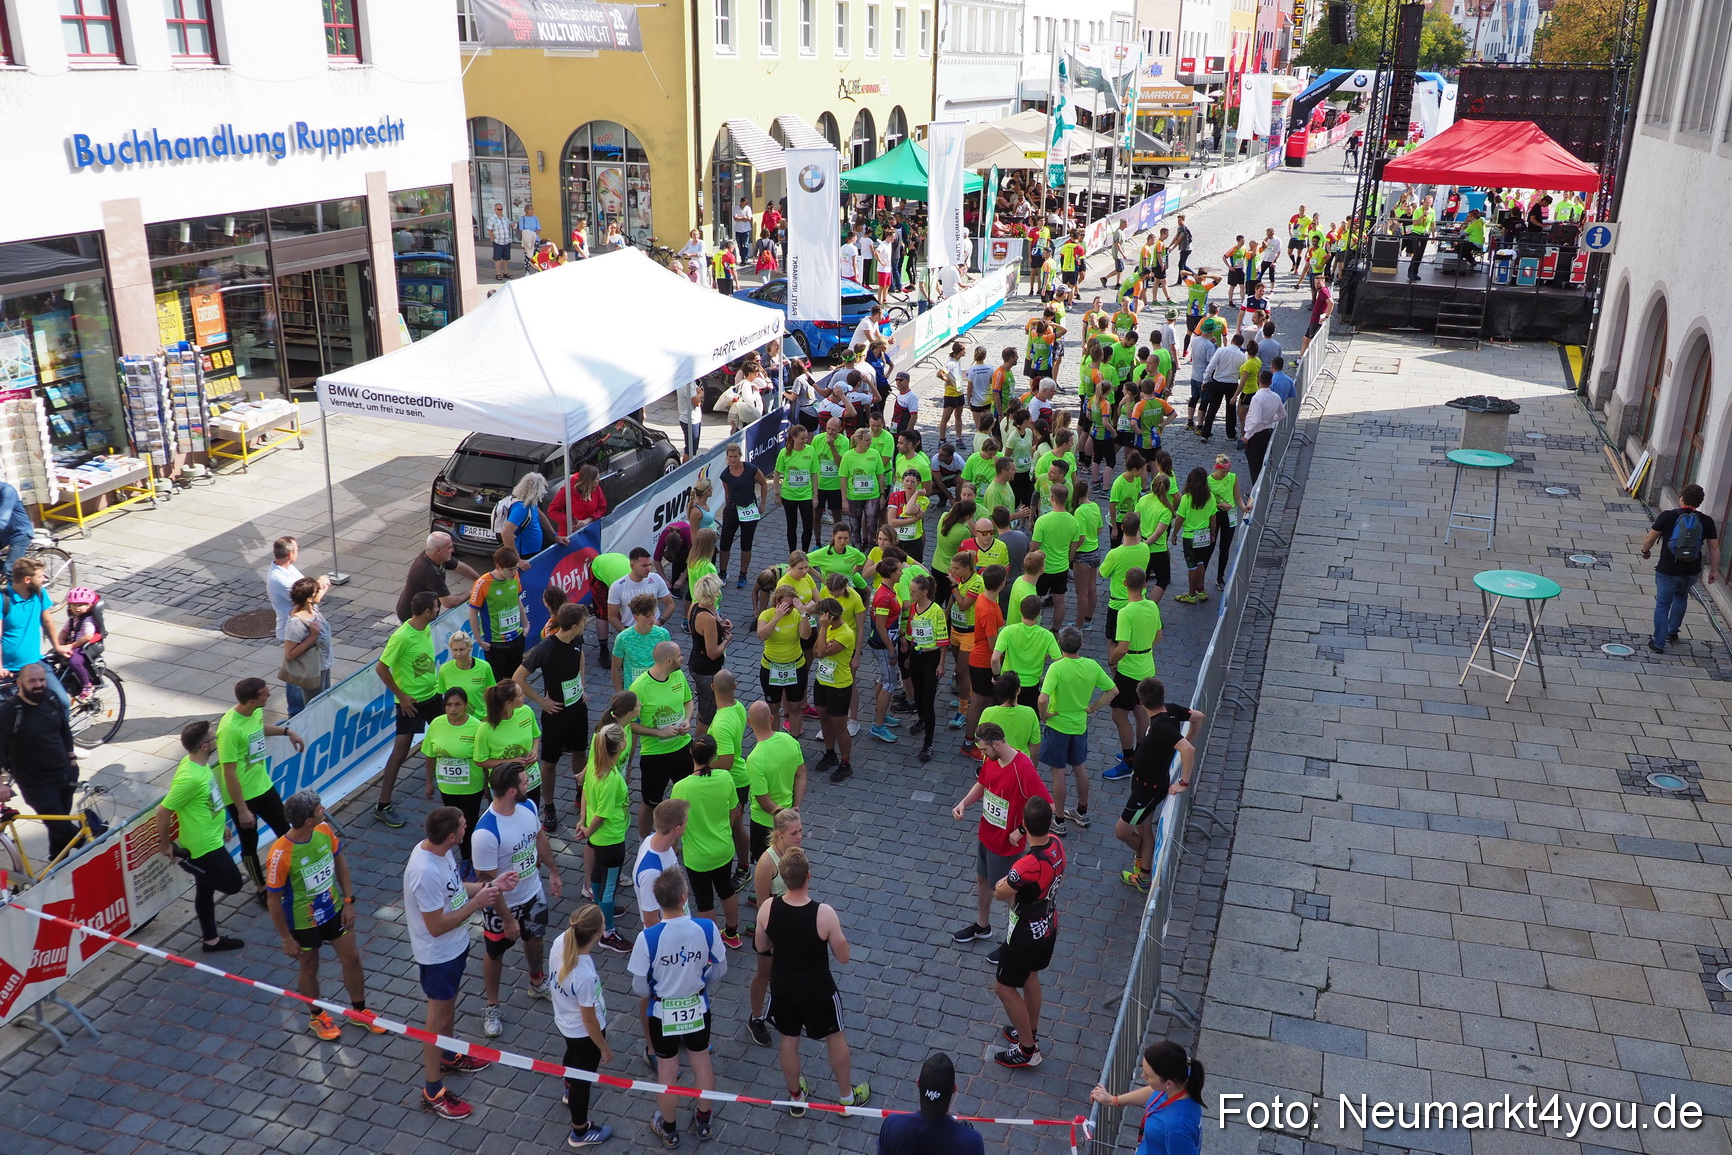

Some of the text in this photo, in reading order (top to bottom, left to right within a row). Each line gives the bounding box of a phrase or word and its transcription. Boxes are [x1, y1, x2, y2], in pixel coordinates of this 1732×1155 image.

[609, 8, 628, 31] 28.
[537, 22, 611, 43] KULTURNACHT
[72, 114, 405, 168] Buchhandlung Rupprecht
[712, 324, 770, 360] PARTL Neumarkt
[328, 384, 454, 411] BMW ConnectedDrive
[329, 397, 365, 411] Vernetzt,
[366, 404, 379, 412] um
[380, 404, 393, 413] frei
[405, 409, 425, 418] sein.
[749, 430, 785, 463] RAIL.ONE
[464, 526, 478, 536] PAR
[550, 557, 593, 594] Hervi
[777, 671, 789, 679] 69
[443, 766, 463, 776] 150
[987, 802, 1001, 817] 135
[519, 854, 536, 870] 138
[313, 866, 331, 884] 126
[29, 946, 67, 969] Braun
[660, 945, 702, 967] SUSPA
[0, 973, 21, 1006] aun
[665, 996, 699, 1008] BOCK
[671, 1008, 696, 1022] 137
